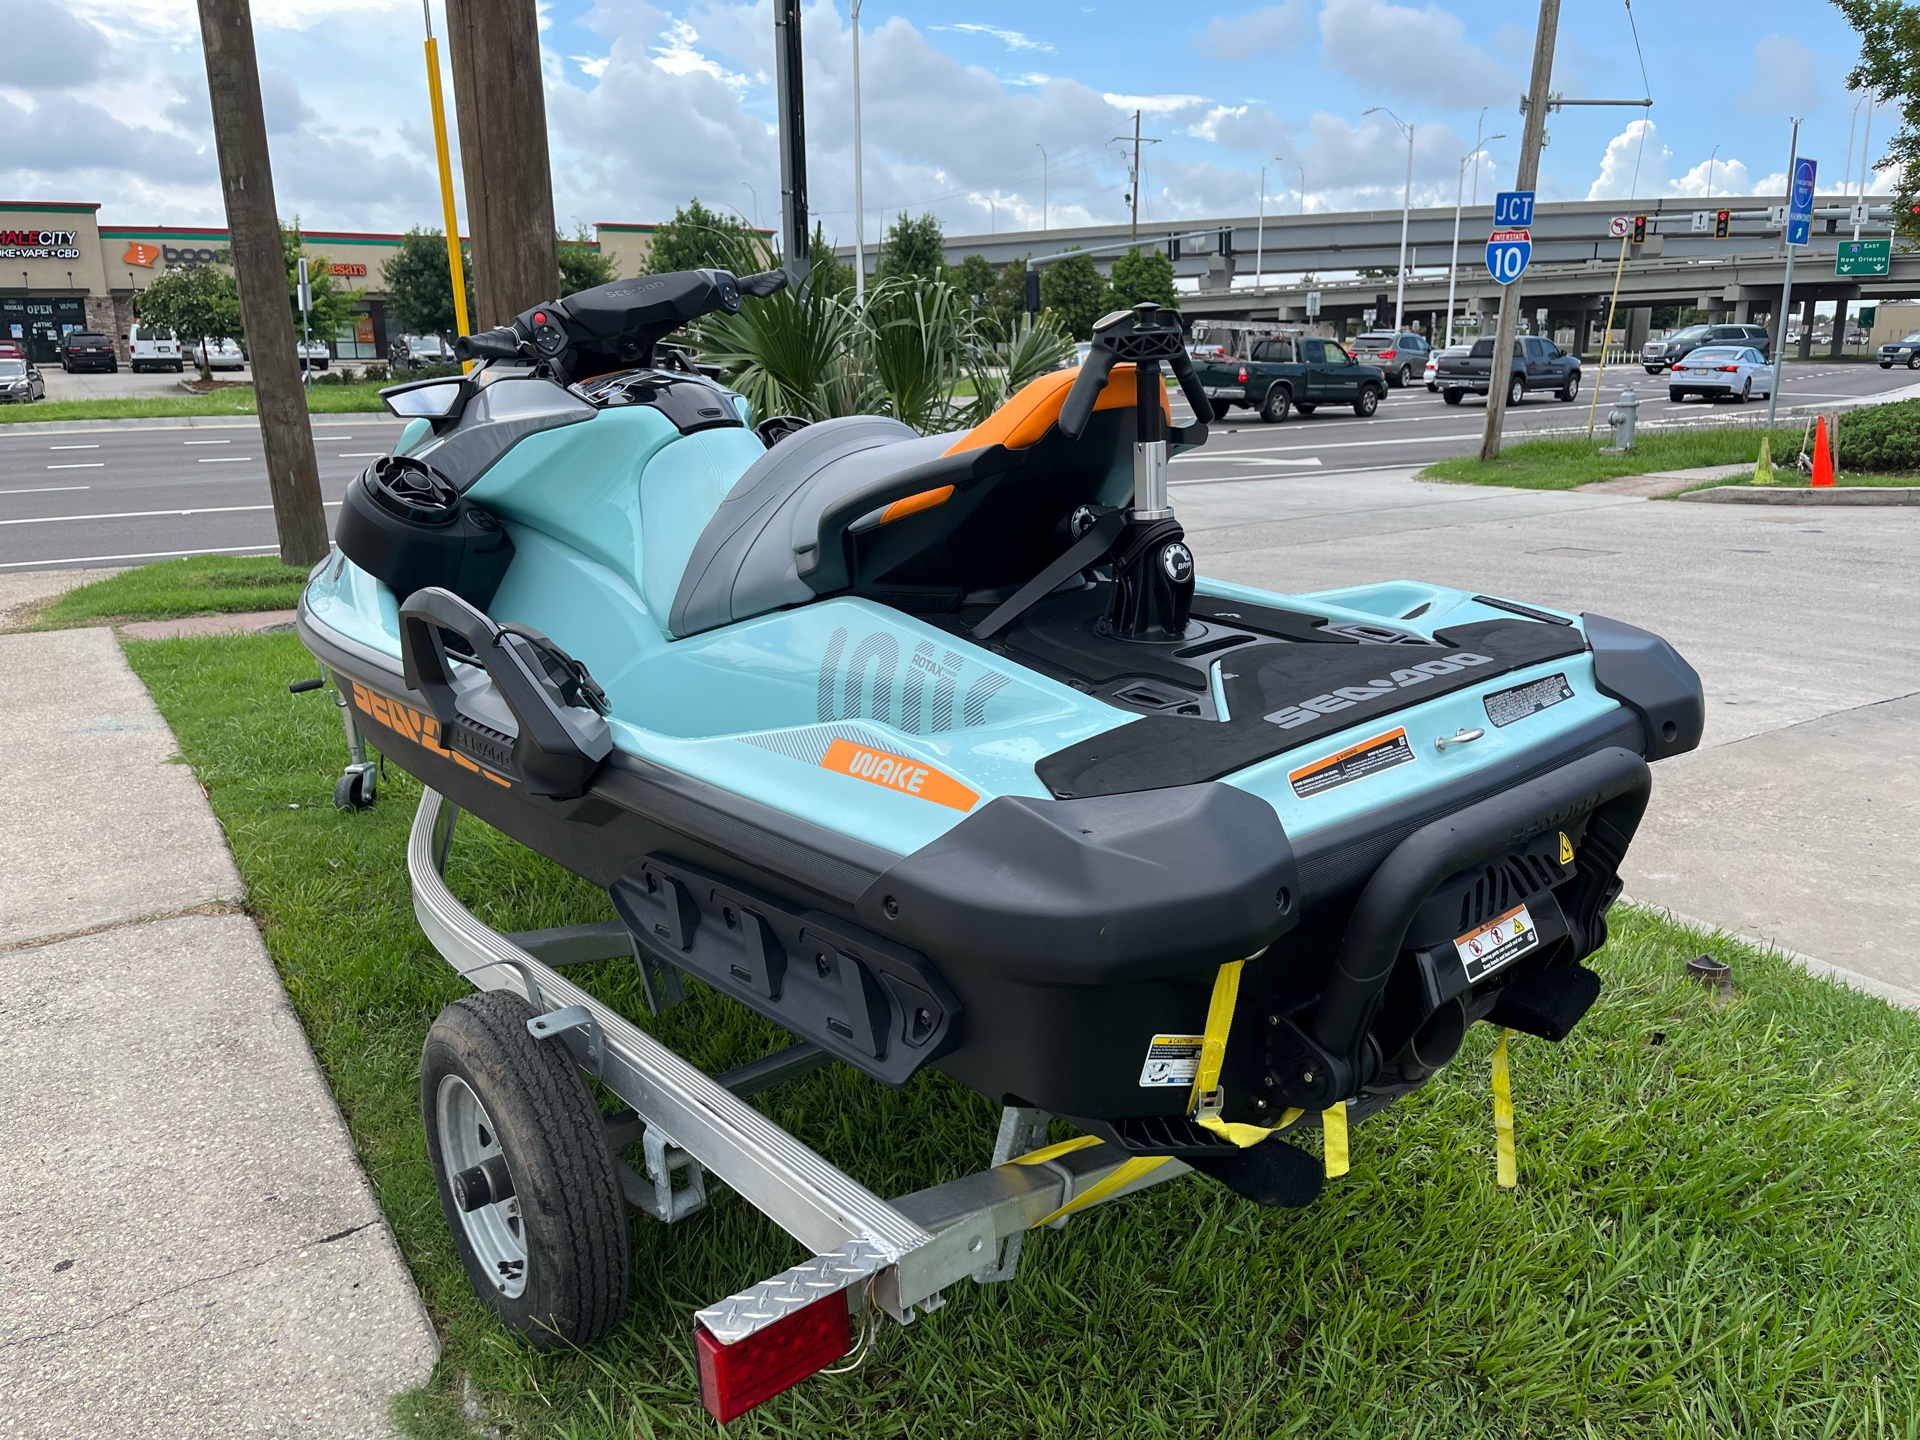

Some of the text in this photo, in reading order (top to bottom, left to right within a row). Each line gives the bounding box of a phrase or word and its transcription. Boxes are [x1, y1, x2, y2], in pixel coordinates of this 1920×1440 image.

[1496, 197, 1532, 221] JCT
[1493, 232, 1526, 242] INTERSTATE
[1495, 247, 1522, 277] 10
[27, 304, 53, 315] OPEN
[1177, 562, 1191, 570] BRP
[911, 653, 945, 678] ROTAX
[1340, 748, 1359, 760] WARNING
[849, 750, 929, 793] WAKE
